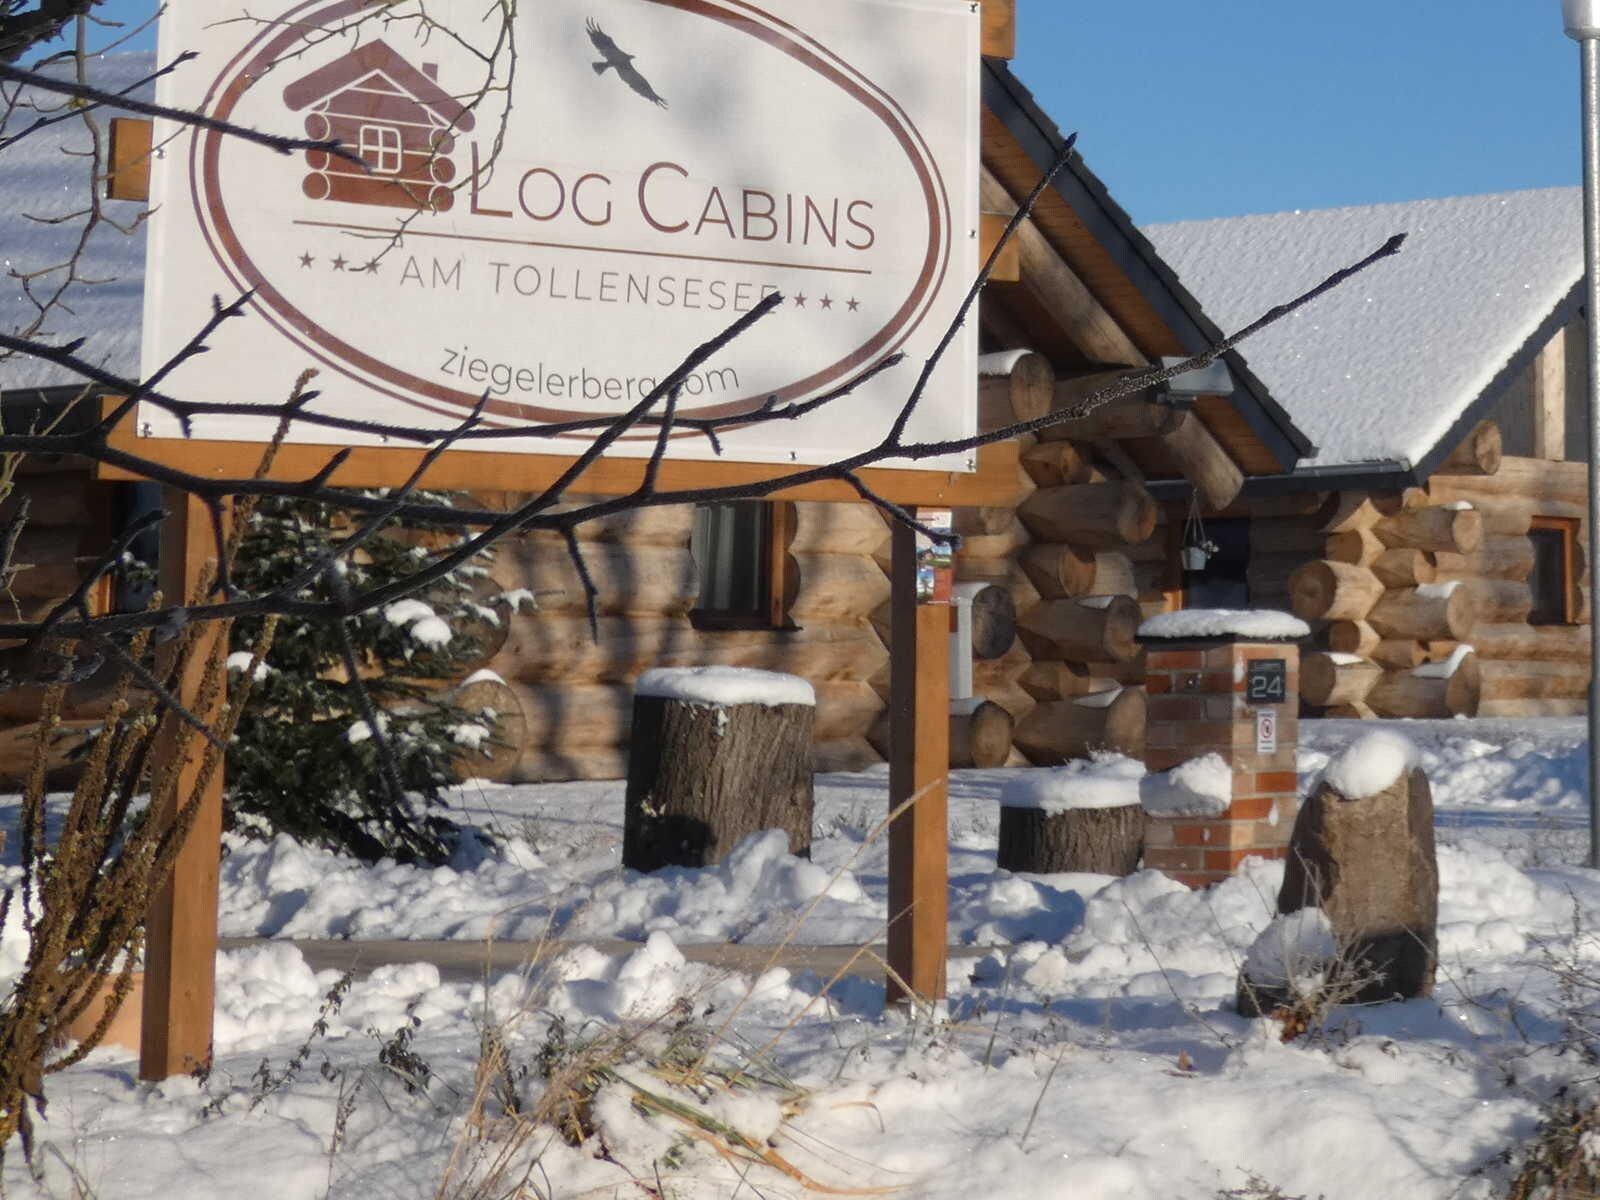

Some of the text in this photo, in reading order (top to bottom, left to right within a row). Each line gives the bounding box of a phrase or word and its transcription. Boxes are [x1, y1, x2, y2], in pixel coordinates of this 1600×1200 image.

[470, 141, 876, 250] LOG CABINS
[400, 255, 462, 291] AM
[1252, 675, 1282, 698] 24
